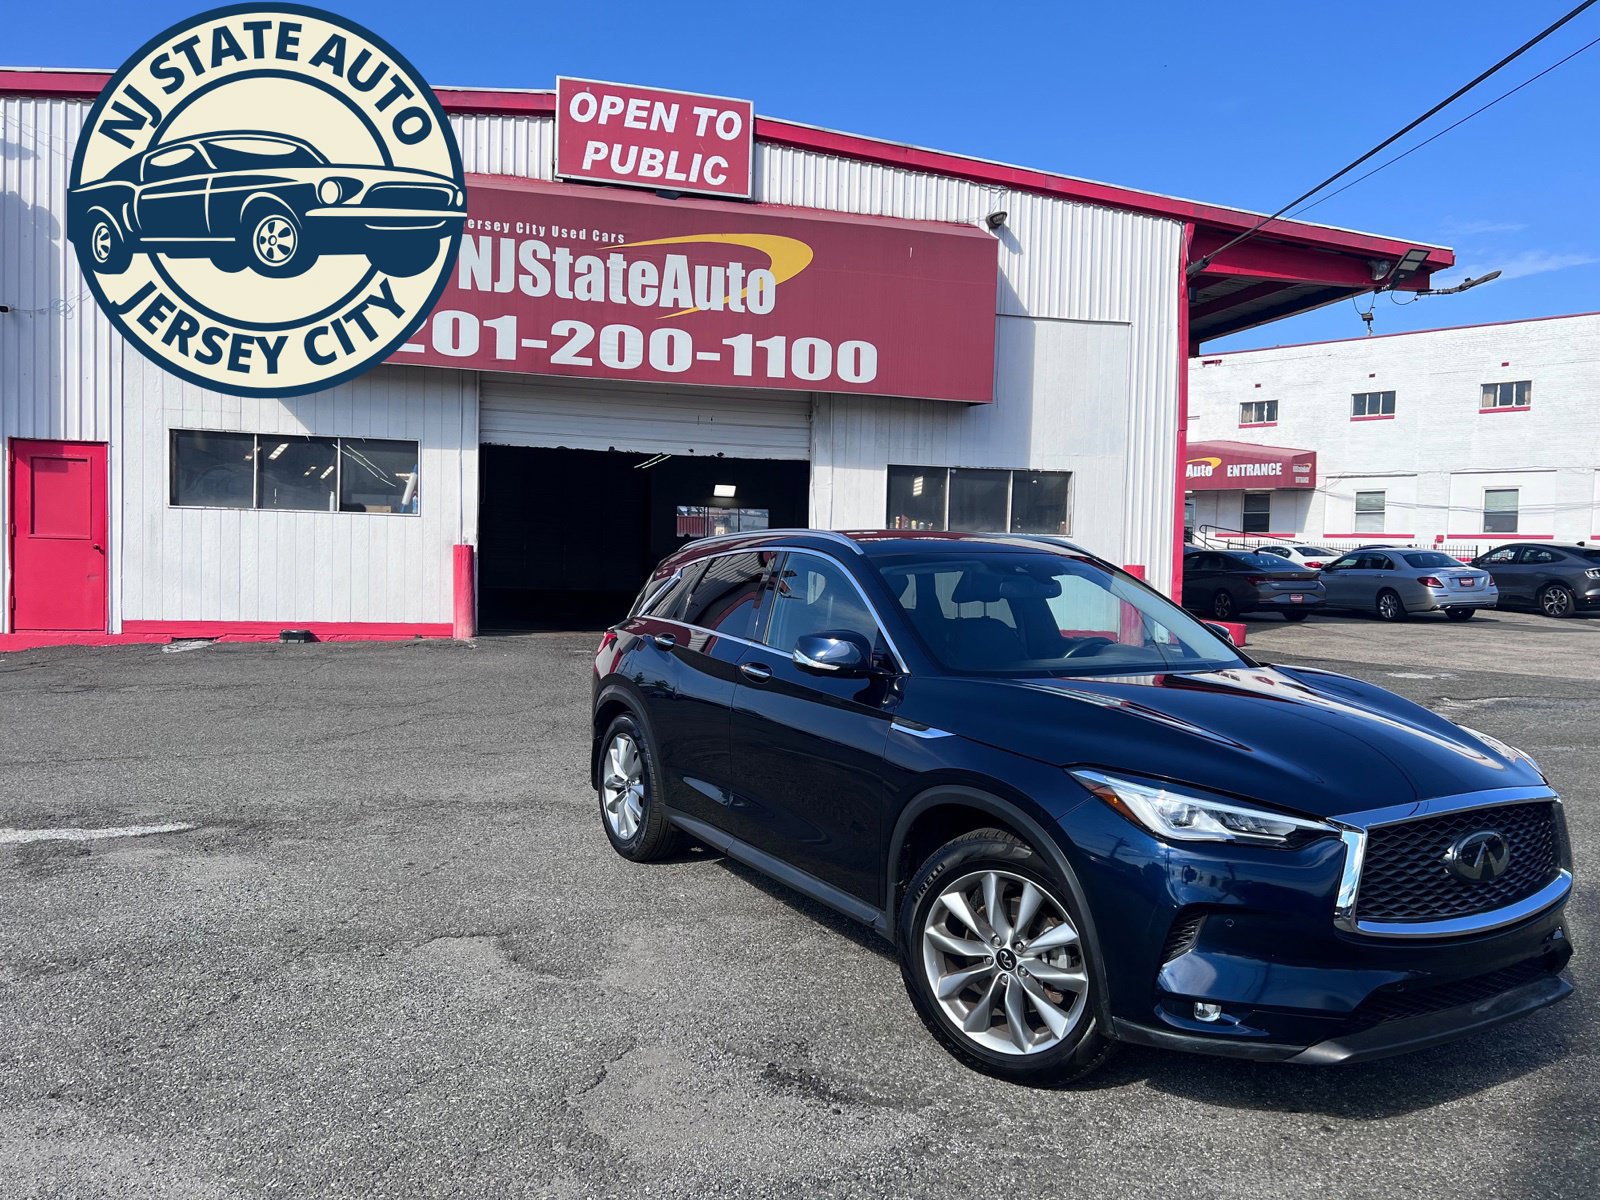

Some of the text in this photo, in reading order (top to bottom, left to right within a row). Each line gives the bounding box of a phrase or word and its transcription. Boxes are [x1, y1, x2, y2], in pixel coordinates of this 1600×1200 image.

[570, 92, 742, 142] OPEN TO
[582, 140, 729, 186] PUBLIC
[465, 219, 625, 244] ersey City Used Cars
[458, 233, 776, 315] NJStateAuto
[1227, 463, 1282, 477] ENTRANCE
